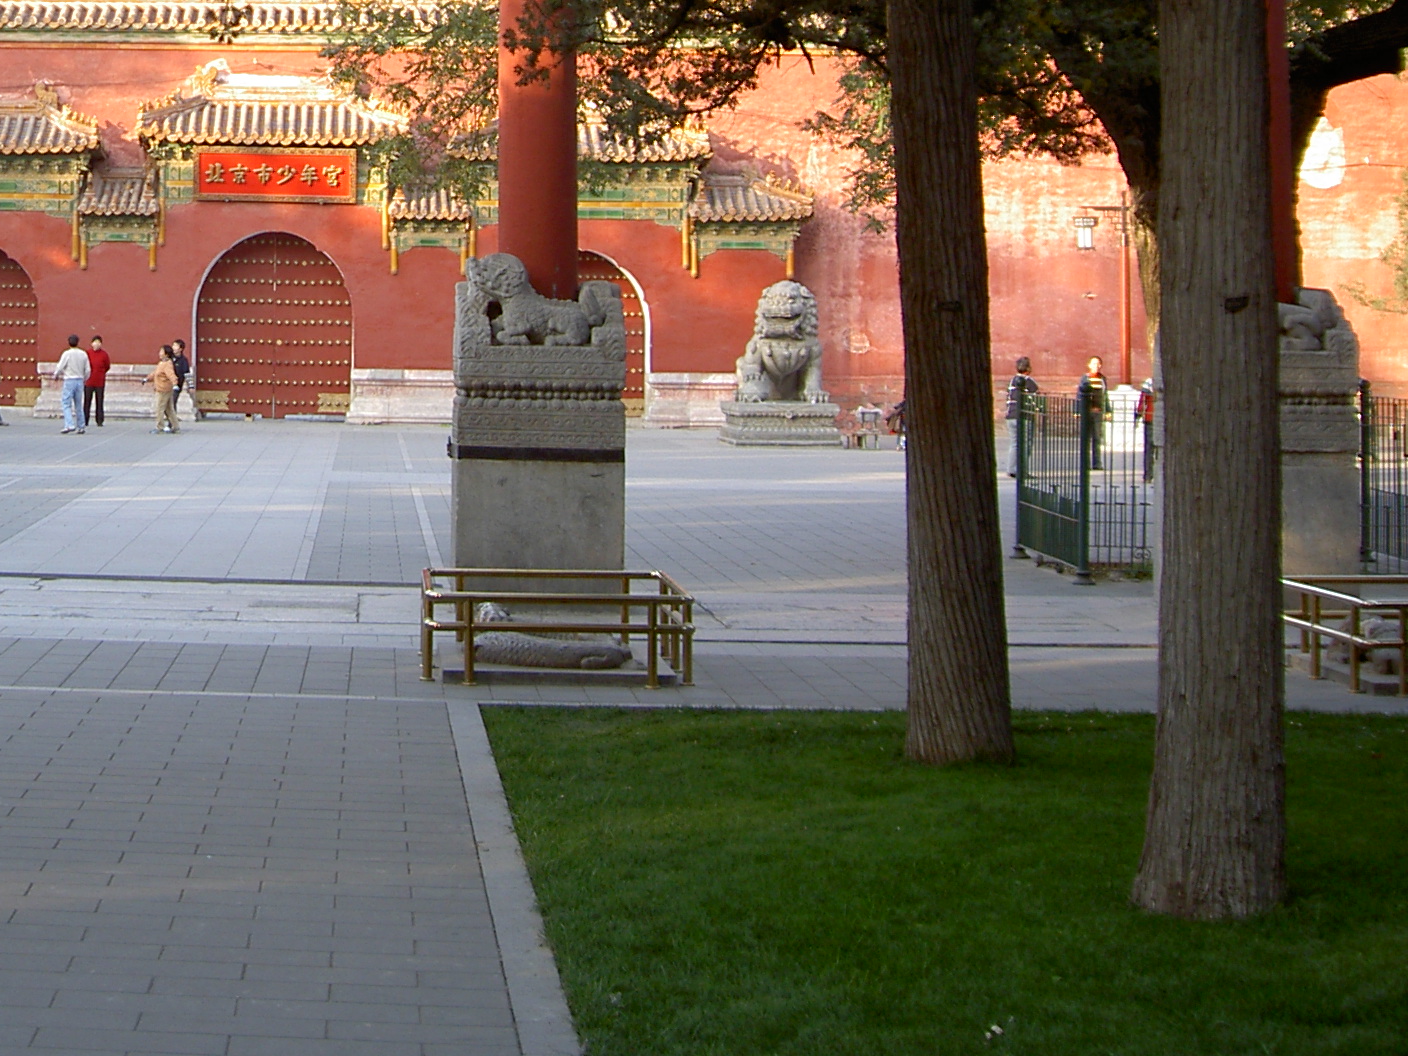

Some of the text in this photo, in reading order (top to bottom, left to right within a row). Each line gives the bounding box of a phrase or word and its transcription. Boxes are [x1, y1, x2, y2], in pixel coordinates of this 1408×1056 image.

[204, 162, 344, 187] 北京市少年宫
